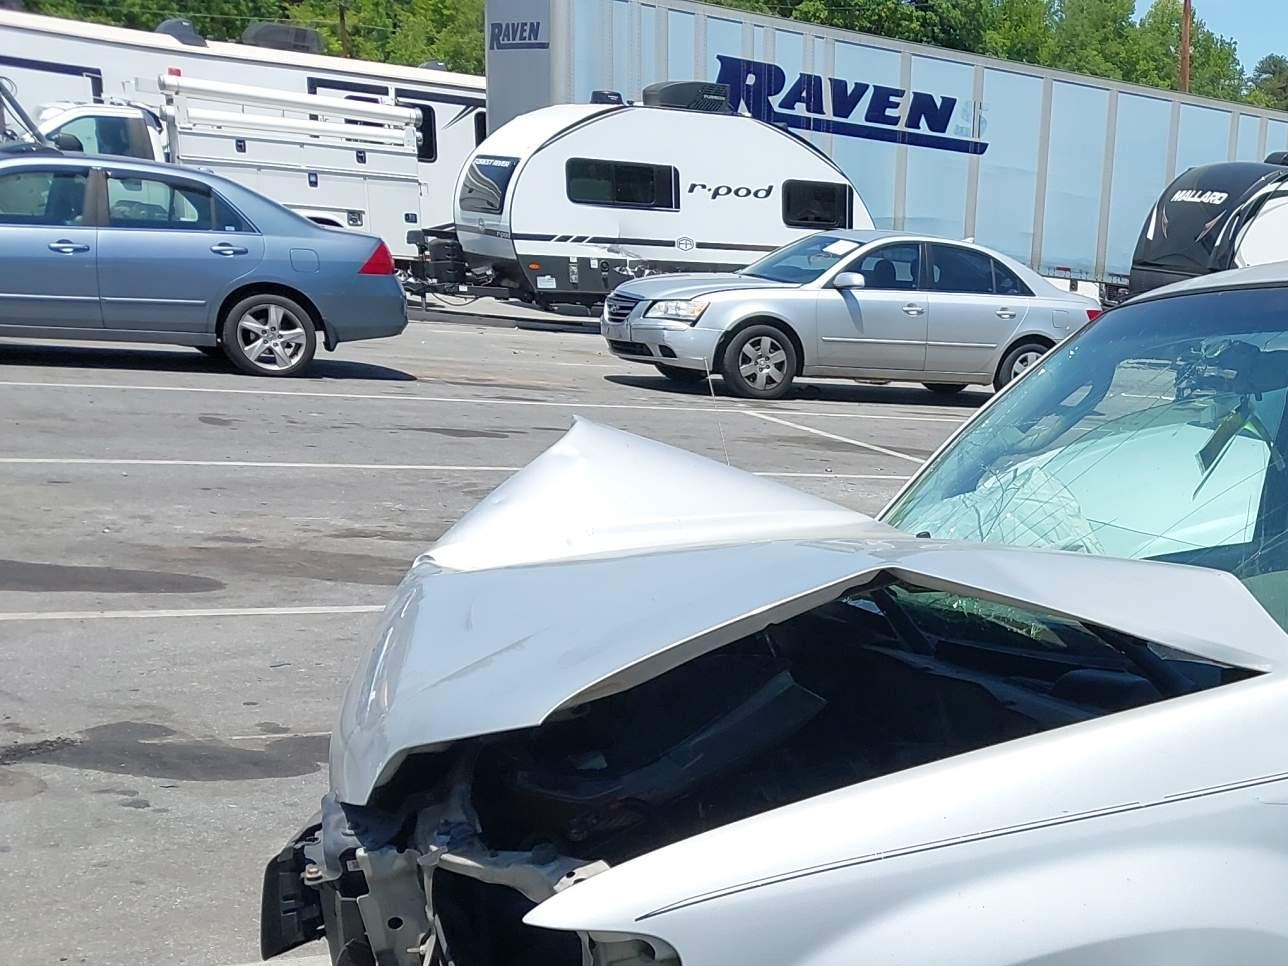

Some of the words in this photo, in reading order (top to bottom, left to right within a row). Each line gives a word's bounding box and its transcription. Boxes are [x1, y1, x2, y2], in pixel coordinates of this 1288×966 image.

[489, 21, 541, 50] RAVEN
[716, 54, 958, 134] RAVEN
[1170, 189, 1229, 205] MALLARD
